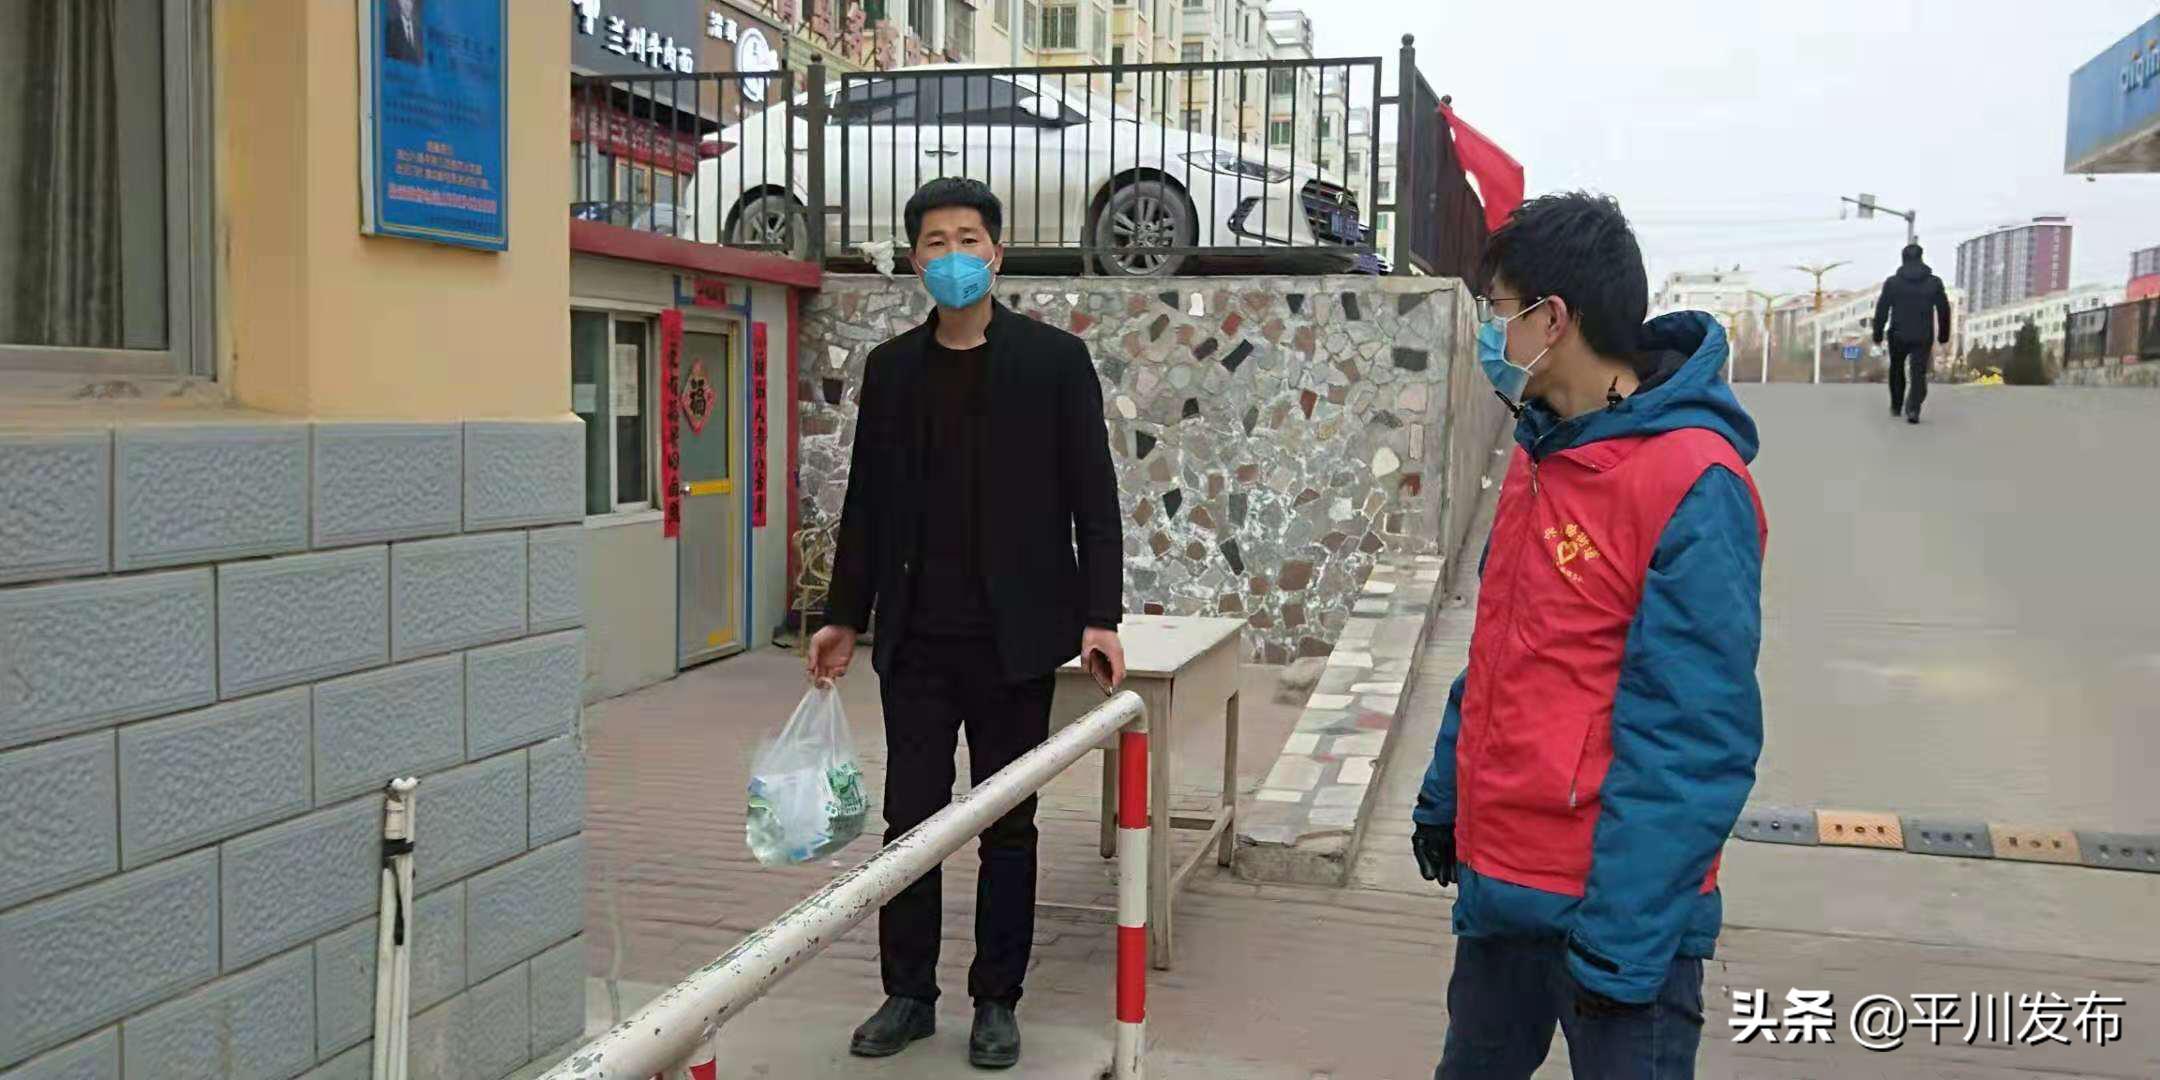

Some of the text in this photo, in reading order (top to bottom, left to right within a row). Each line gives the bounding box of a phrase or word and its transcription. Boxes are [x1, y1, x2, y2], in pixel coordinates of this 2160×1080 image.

[606, 15, 693, 74] 兰州牛肉面
[689, 378, 707, 416] 福
